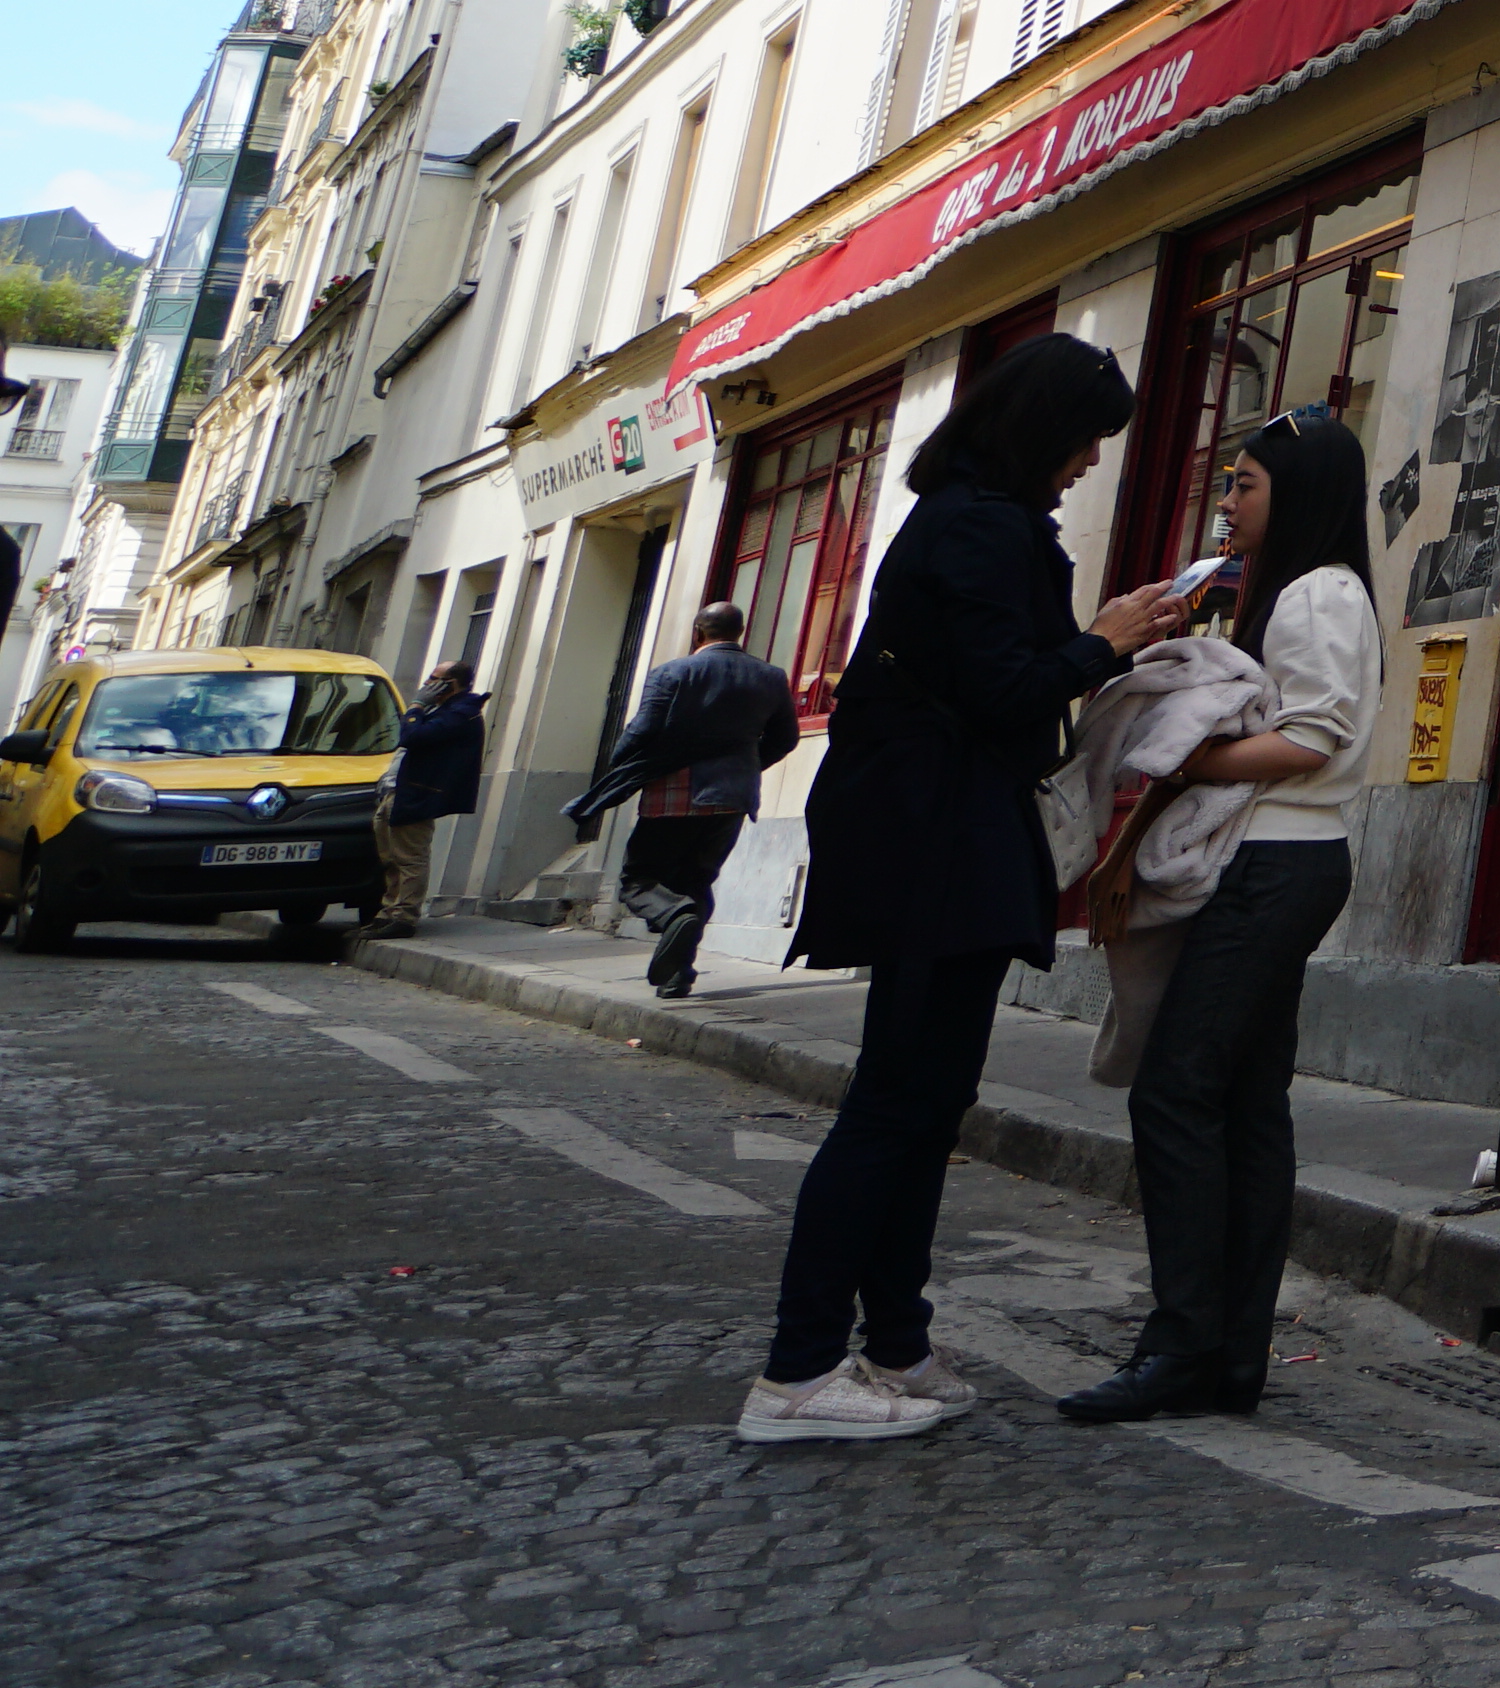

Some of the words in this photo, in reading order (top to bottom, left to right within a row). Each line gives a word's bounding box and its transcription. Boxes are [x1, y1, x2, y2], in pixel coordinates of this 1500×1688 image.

[1027, 125, 1057, 192] 2
[521, 437, 607, 506] SUPERMARCHÉ
[609, 423, 642, 461] G20
[215, 844, 308, 863] DG-988-NY
